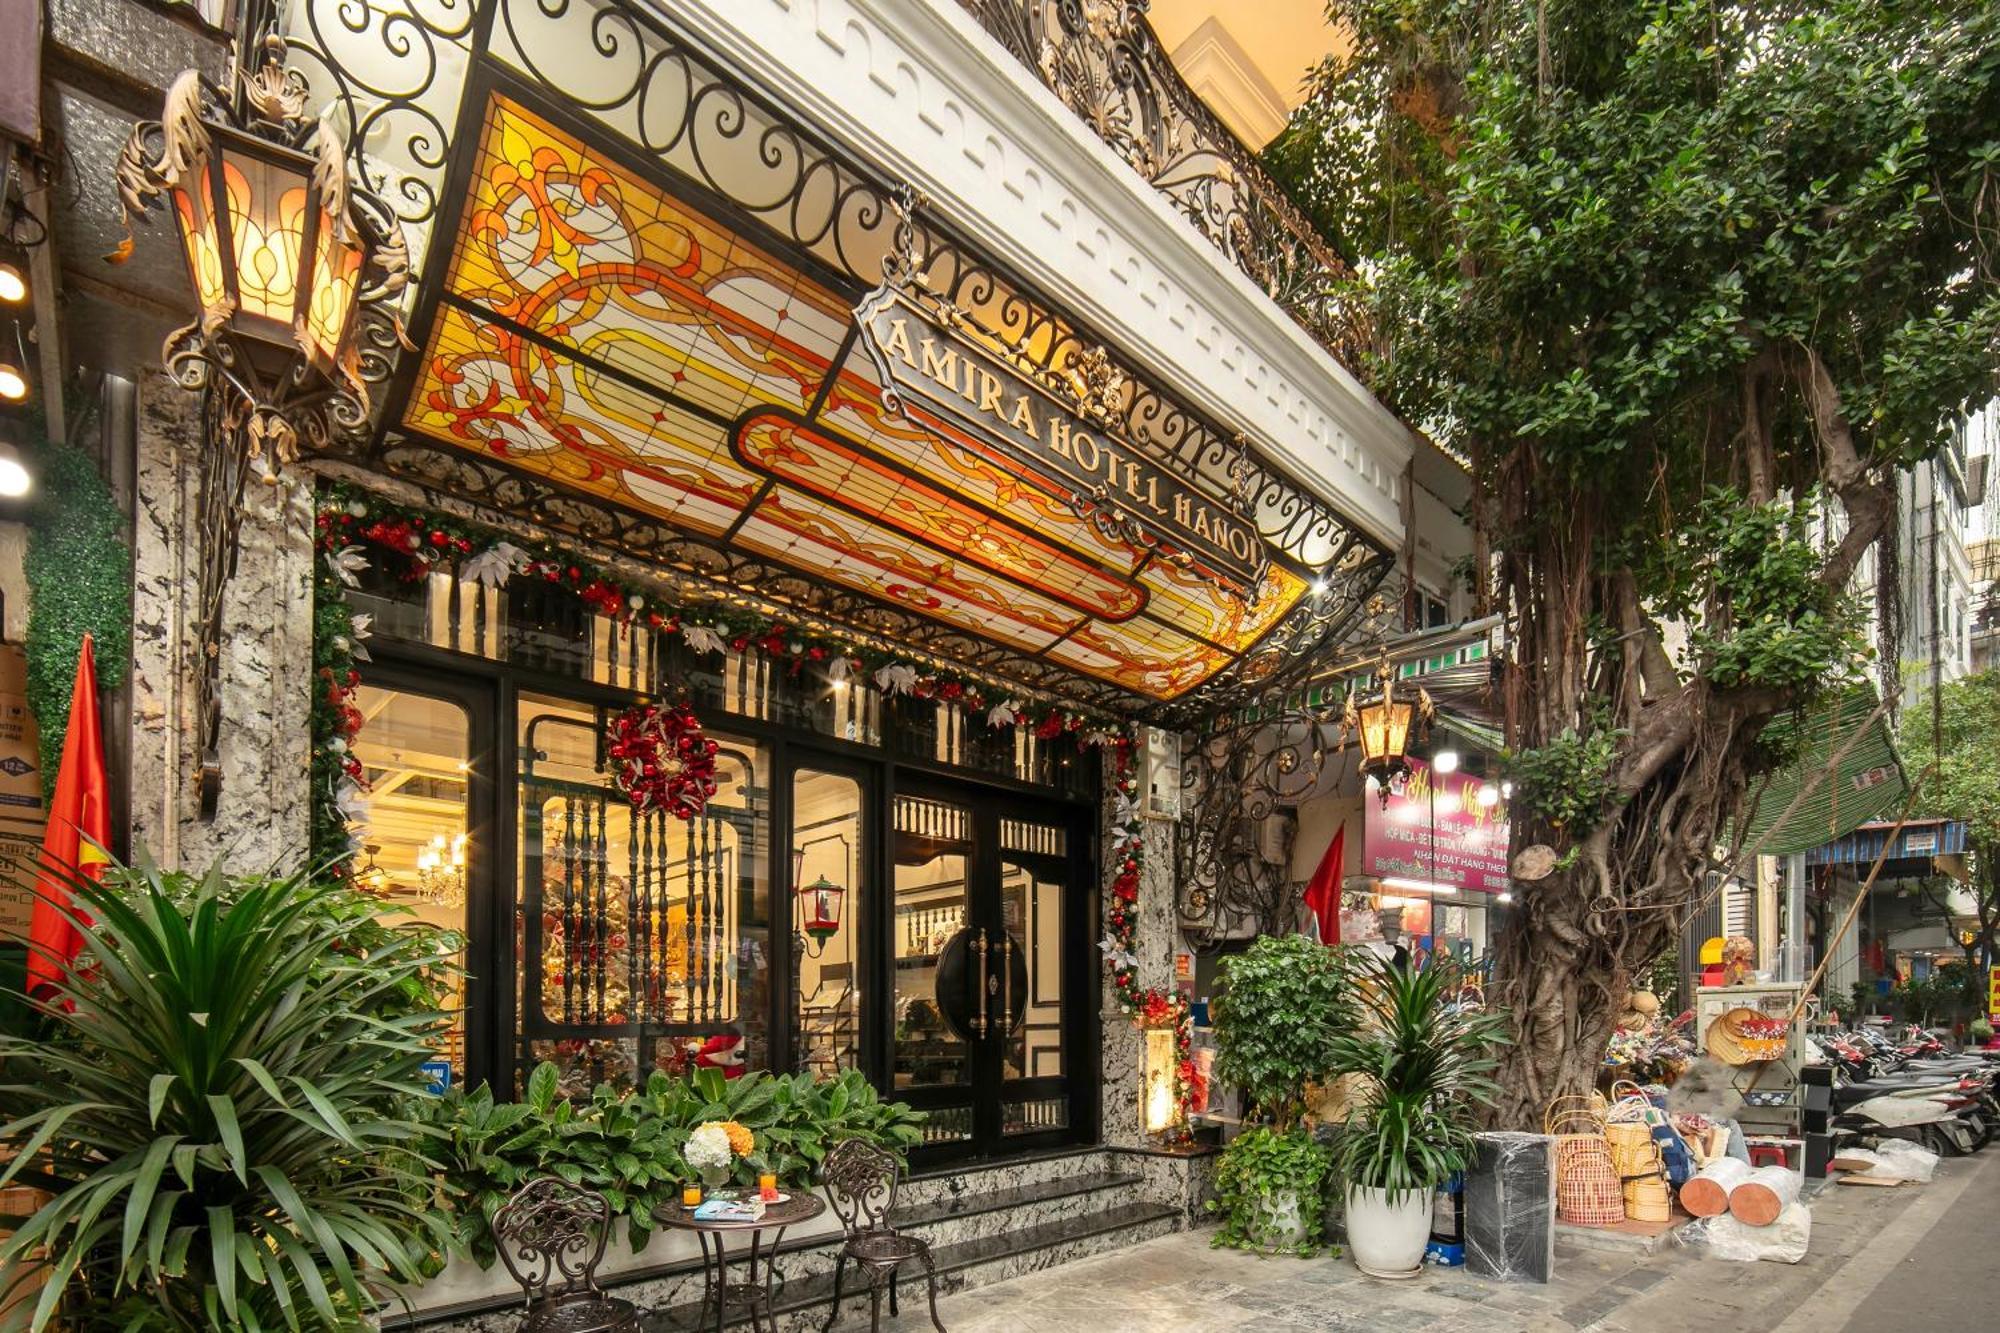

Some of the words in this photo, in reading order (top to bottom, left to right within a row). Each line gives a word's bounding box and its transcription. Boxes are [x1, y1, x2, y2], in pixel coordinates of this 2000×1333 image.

[885, 319, 1039, 441] AMIRA
[1049, 416, 1168, 516] HOTEL
[1173, 492, 1262, 570] HANOI
